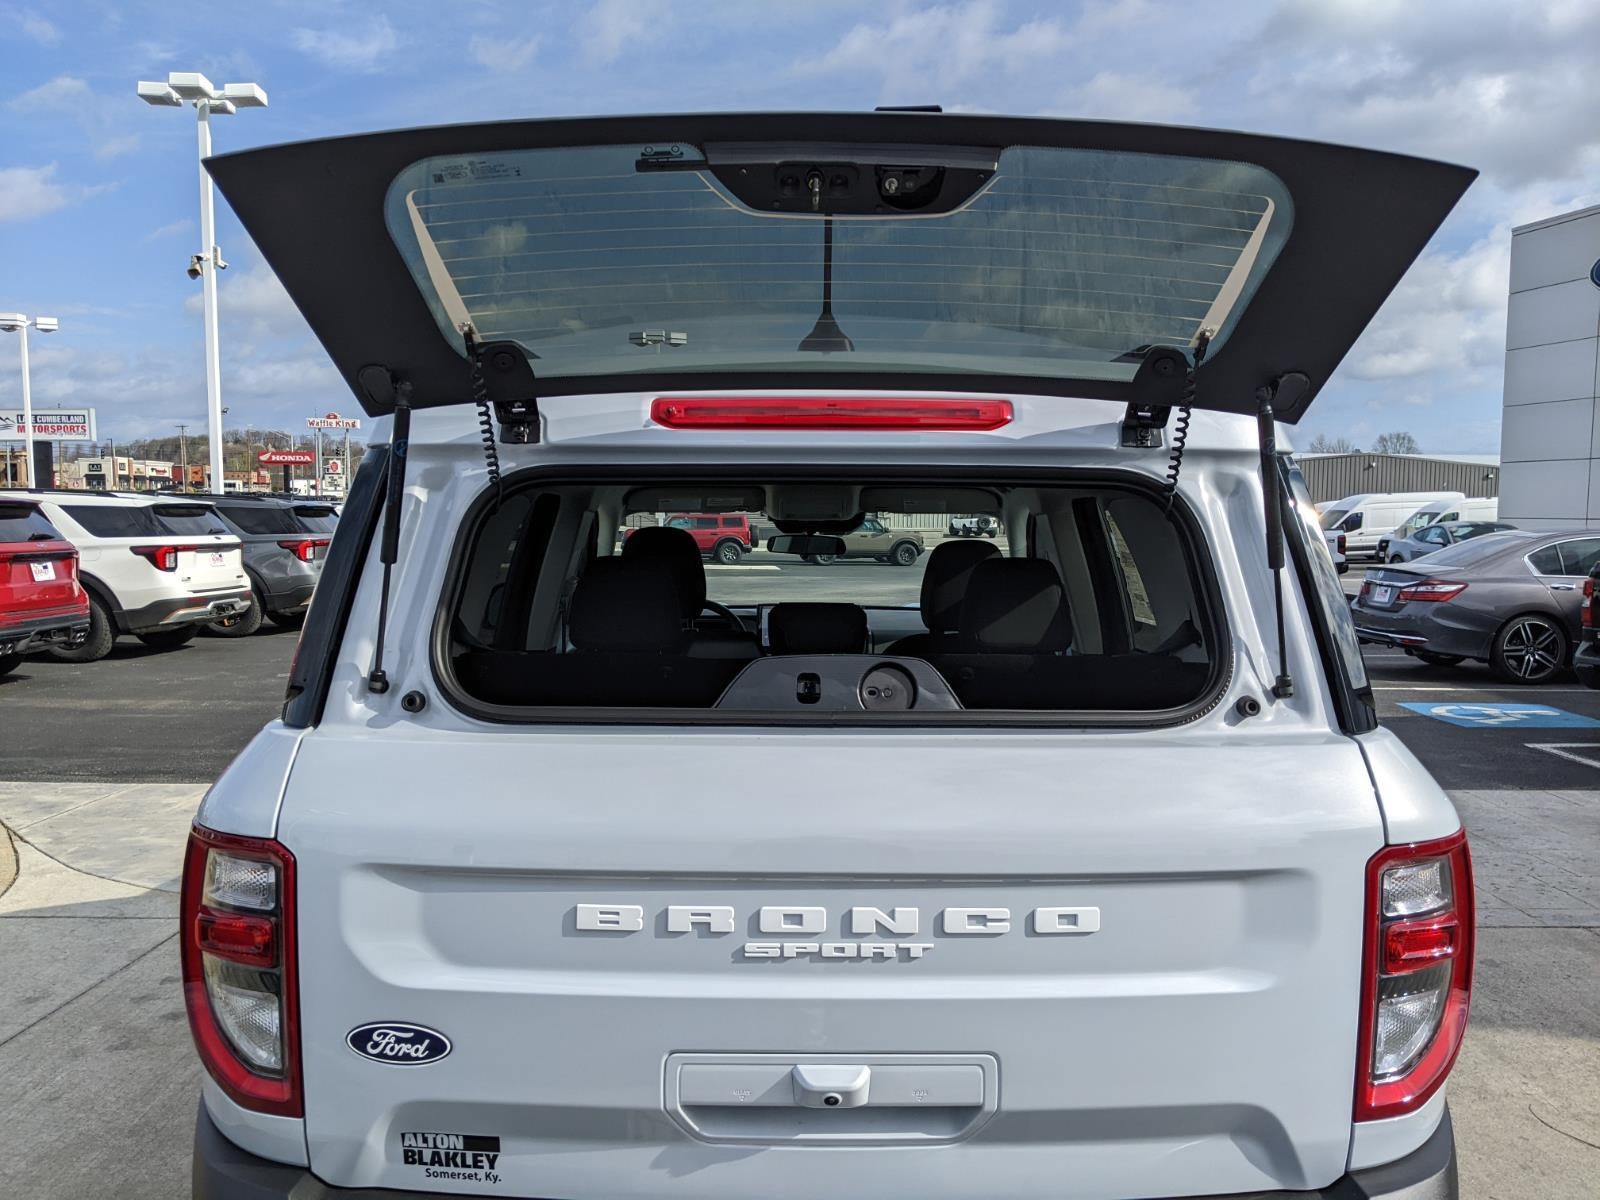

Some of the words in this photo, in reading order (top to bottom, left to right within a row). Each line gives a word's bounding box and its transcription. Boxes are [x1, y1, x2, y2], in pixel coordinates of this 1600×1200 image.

[18, 415, 36, 423] LE
[36, 415, 84, 423] CUMBERLAND
[307, 419, 333, 427] Waffle
[335, 419, 357, 428] King
[17, 425, 87, 433] MTORSPORTS
[575, 903, 1101, 934] BRONCO
[743, 942, 935, 959] SPORT
[366, 1029, 431, 1058] Ford
[403, 1133, 465, 1150] ALTON
[403, 1148, 499, 1170] BLAKLEY
[425, 1168, 482, 1183] Somerset,
[484, 1171, 502, 1184] Ky.
